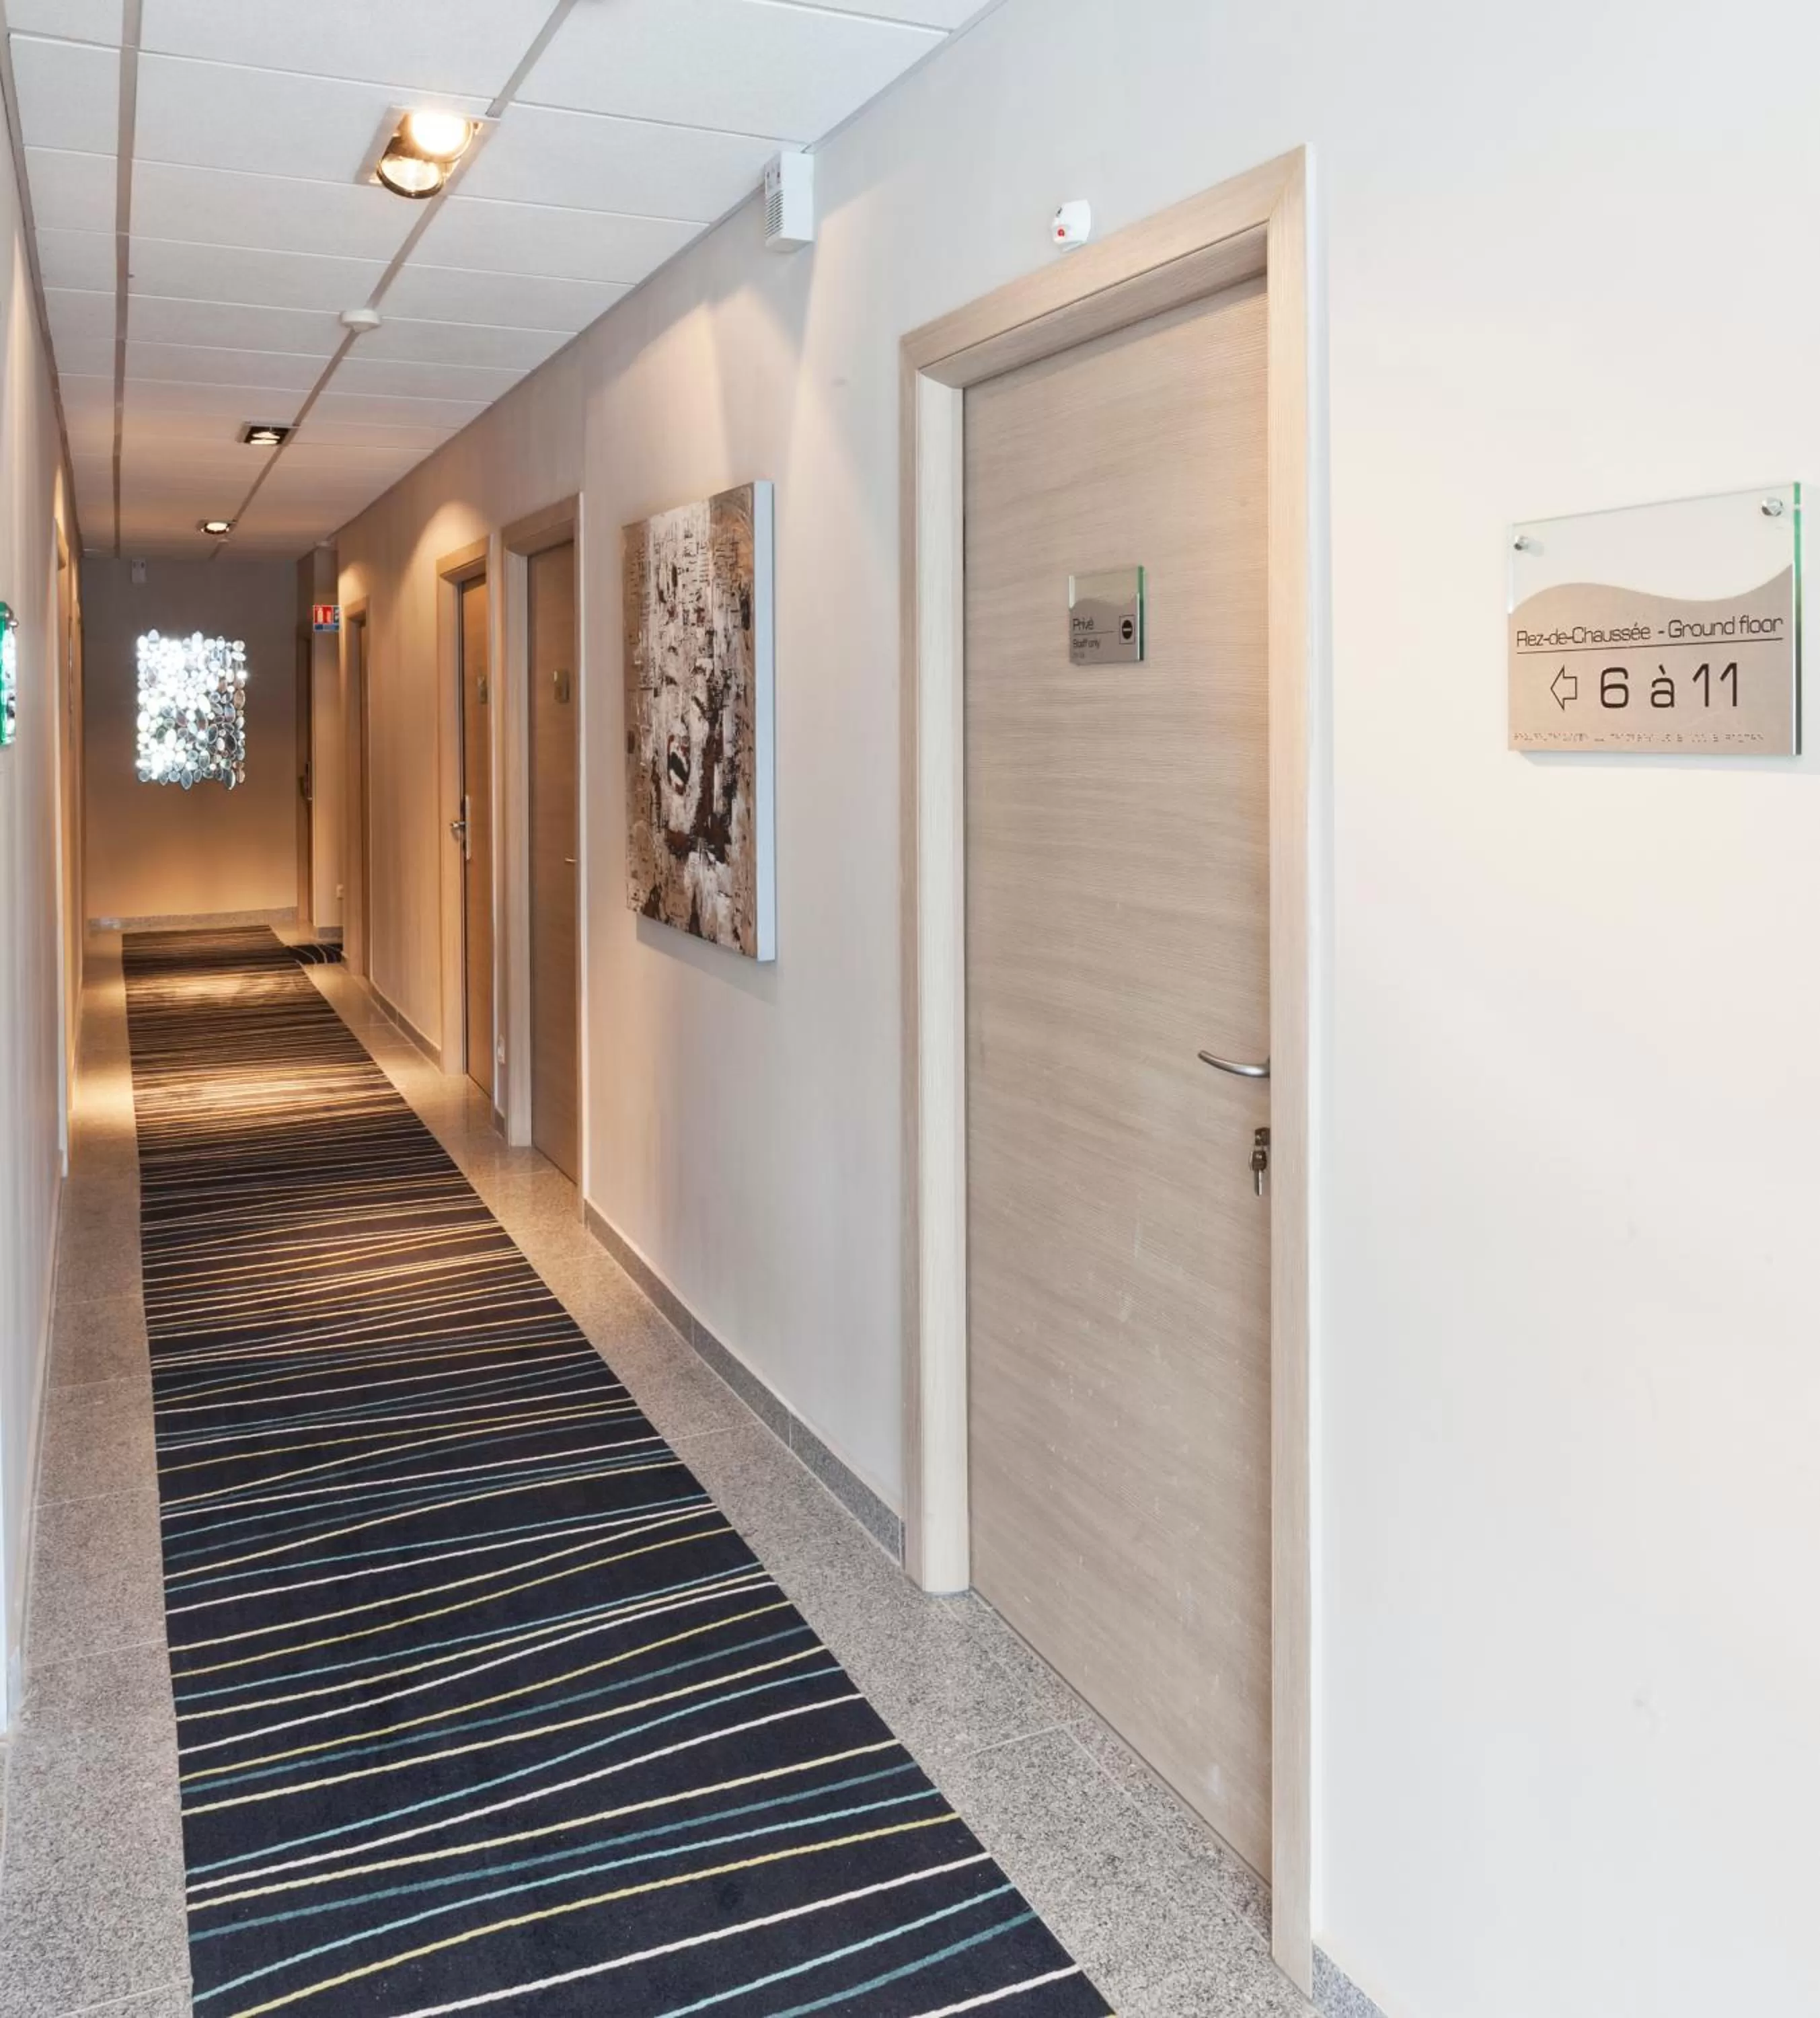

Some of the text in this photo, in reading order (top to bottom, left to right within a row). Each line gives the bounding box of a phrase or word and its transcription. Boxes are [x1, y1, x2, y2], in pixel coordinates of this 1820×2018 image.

[1517, 622, 1652, 648] Rez-de-Chaussée
[1668, 615, 1735, 638] Ground
[1739, 614, 1784, 634] floor
[1599, 662, 1739, 709] 6 à 11
